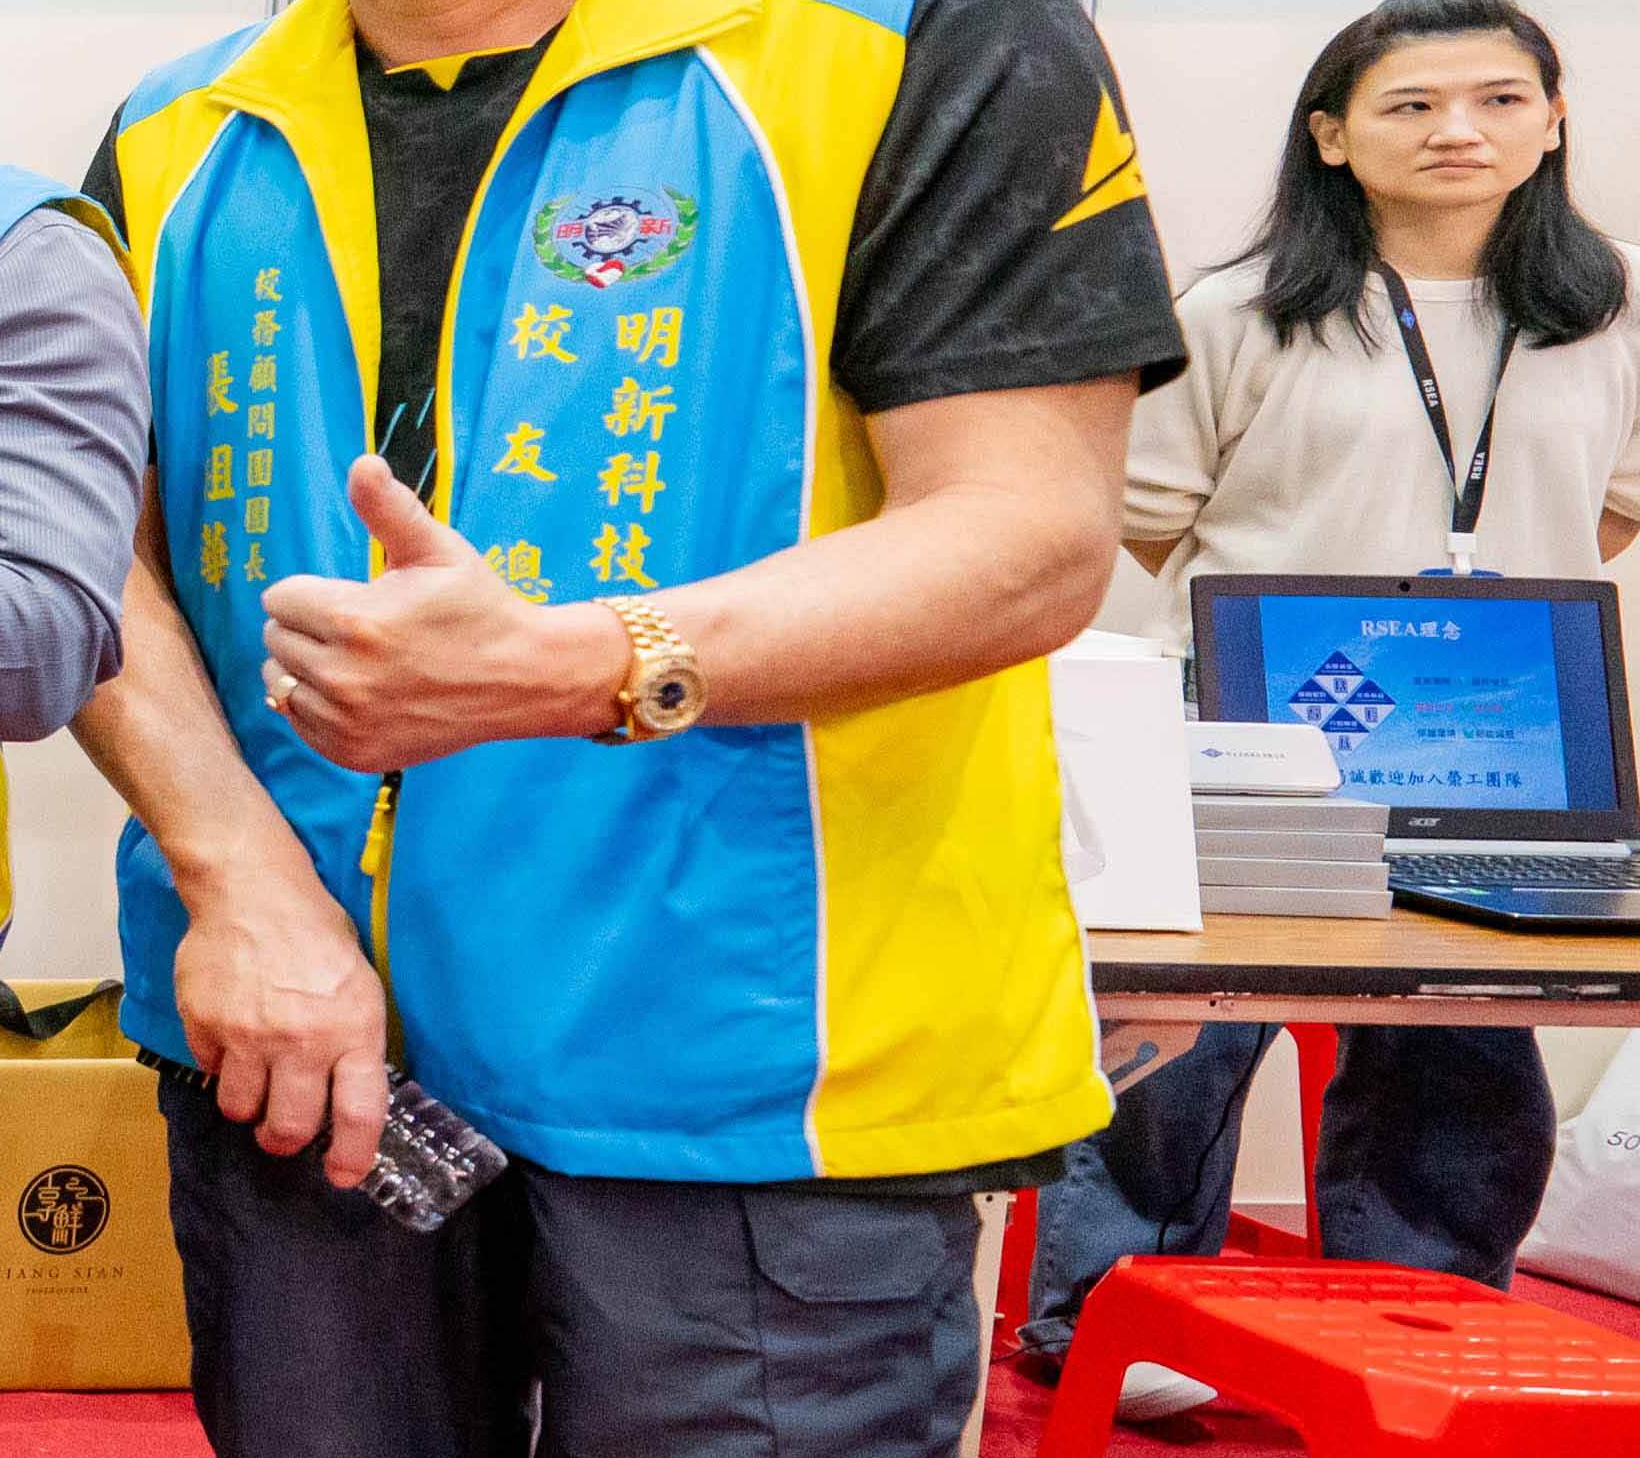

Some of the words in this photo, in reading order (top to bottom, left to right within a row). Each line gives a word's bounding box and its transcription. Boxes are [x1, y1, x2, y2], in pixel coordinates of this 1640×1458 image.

[1422, 378, 1440, 408] RSEA
[588, 305, 684, 591] 明新科技
[1407, 816, 1442, 827] acer
[72, 1266, 125, 1280] SIAN
